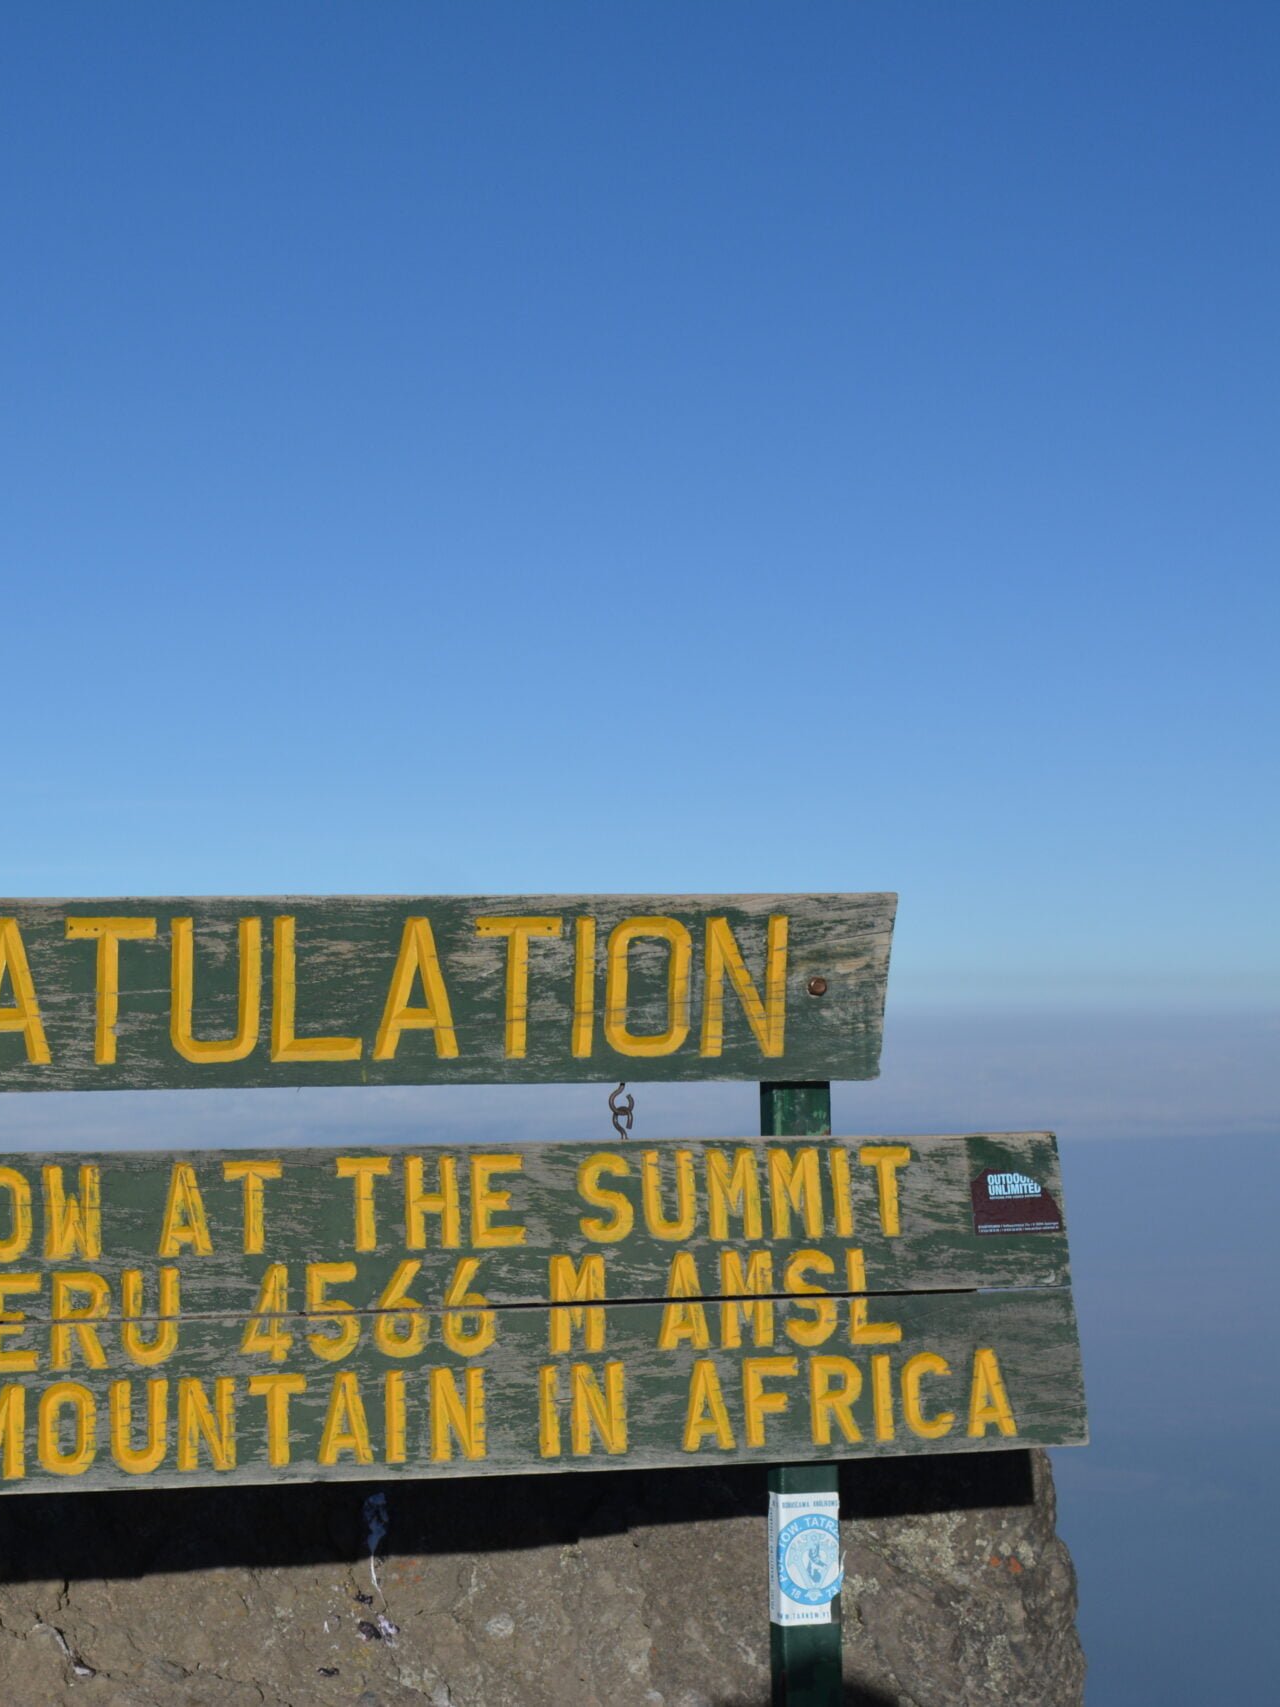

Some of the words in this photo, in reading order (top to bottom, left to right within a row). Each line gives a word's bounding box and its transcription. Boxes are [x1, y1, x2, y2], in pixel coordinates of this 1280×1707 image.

[159, 1160, 282, 1257] AT
[336, 1154, 525, 1251] THE
[578, 1146, 910, 1242] SUMMIT
[988, 1182, 1041, 1196] UNLIMITED
[240, 1257, 496, 1362] 4566
[549, 1255, 606, 1353] M
[659, 1248, 902, 1349] AMSL
[539, 1361, 627, 1457] IN
[682, 1348, 1017, 1452] AFRICA
